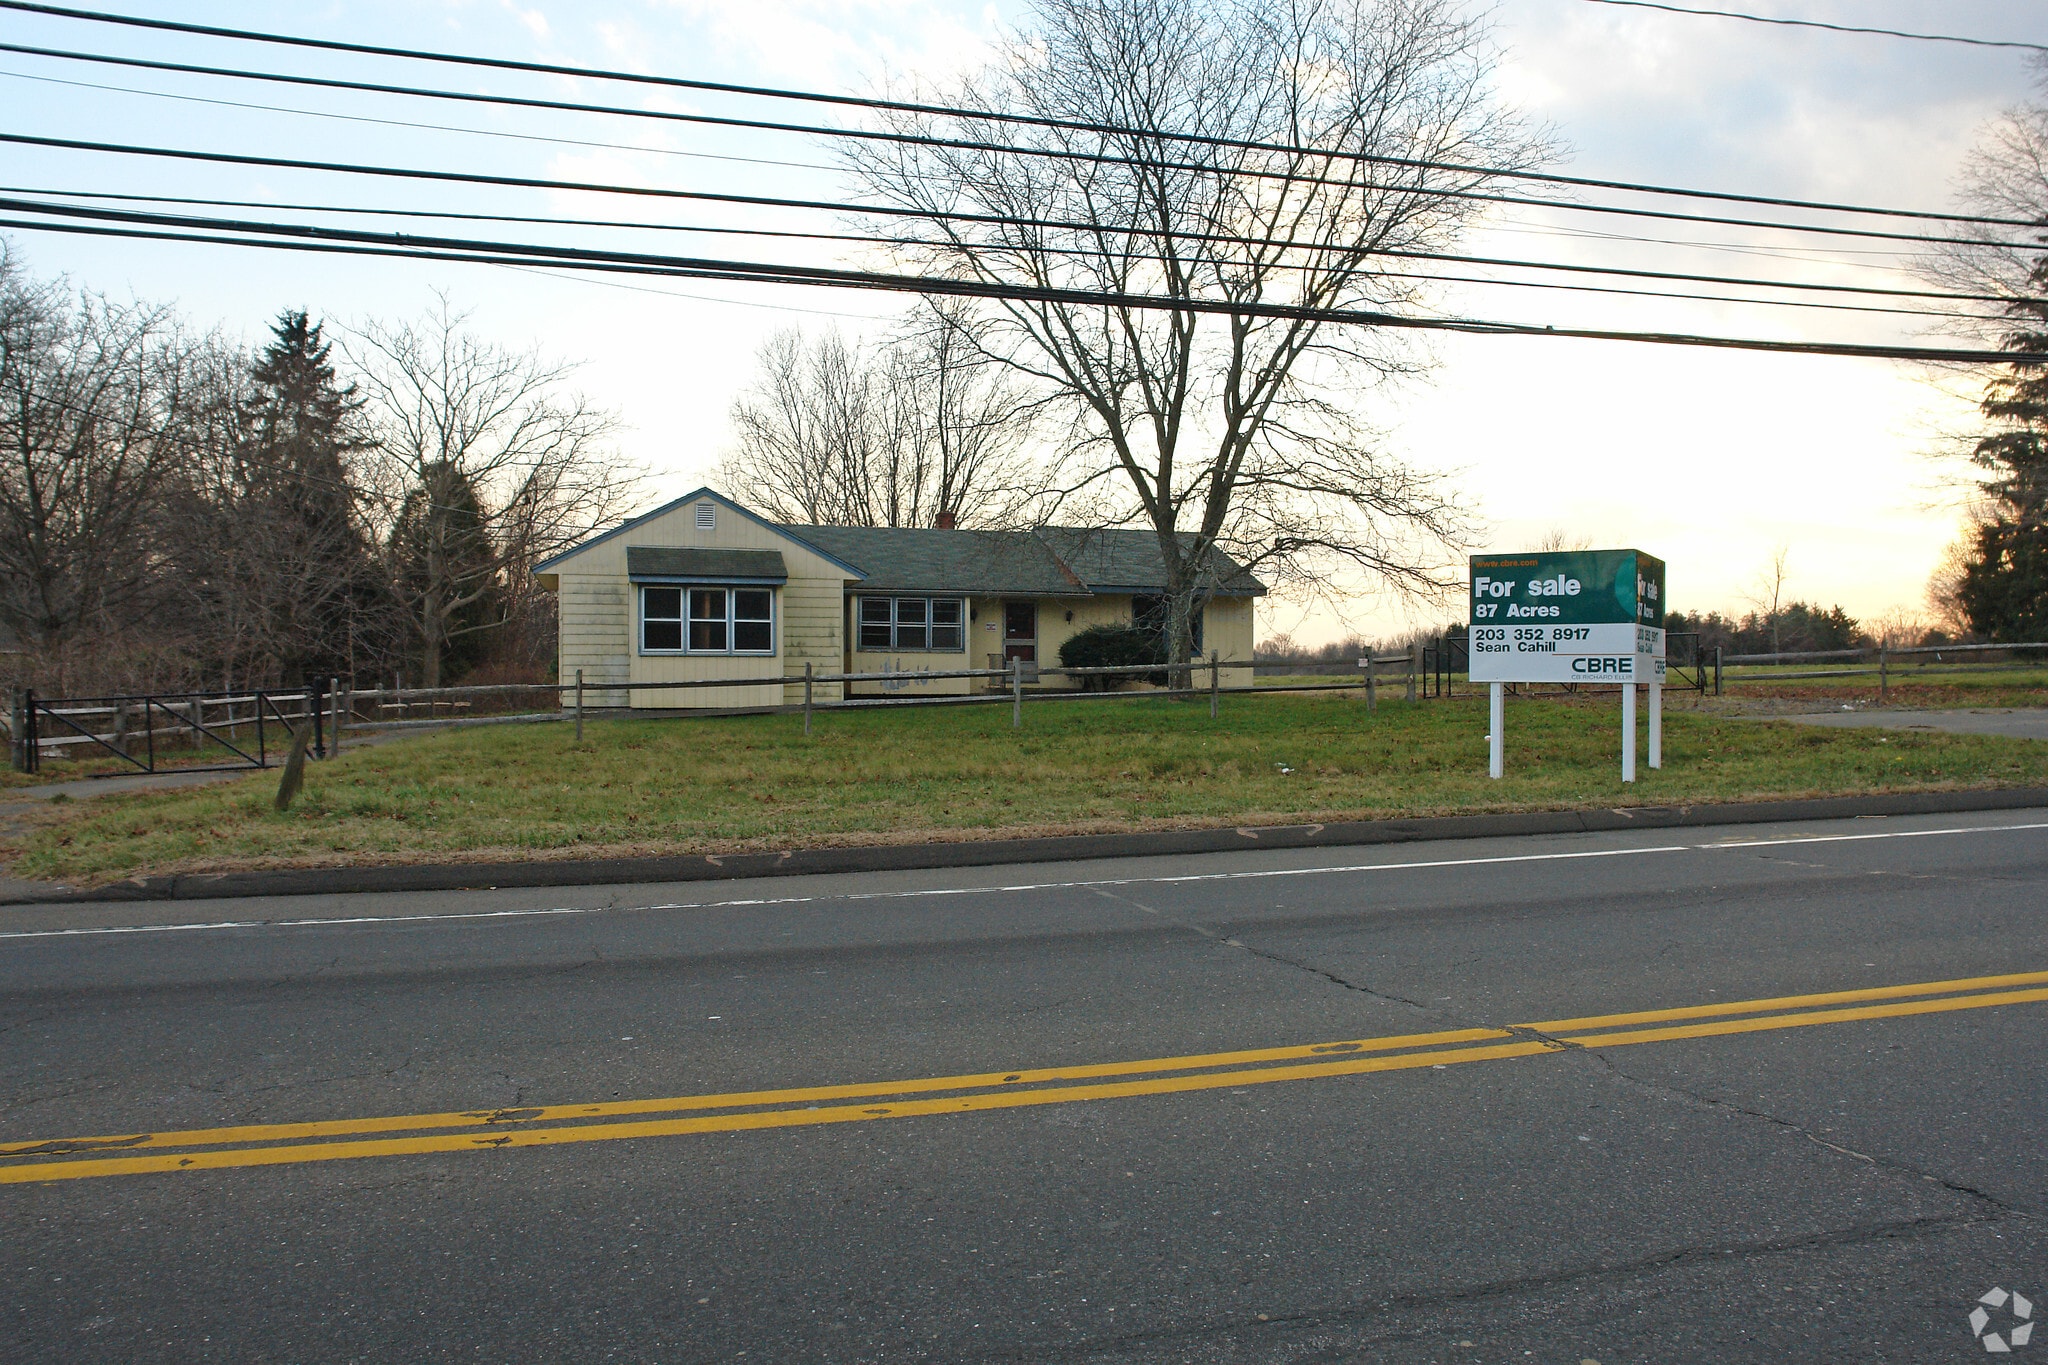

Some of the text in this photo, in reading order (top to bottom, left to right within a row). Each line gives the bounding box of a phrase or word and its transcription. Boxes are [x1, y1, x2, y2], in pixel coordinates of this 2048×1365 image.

[1475, 559, 1539, 568] www.cbre.com
[1475, 574, 1581, 598] For sale
[1475, 603, 1560, 618] 87 Acres
[1475, 628, 1590, 641] 203 352 8917
[1475, 641, 1556, 652] Sean Cahill
[1572, 658, 1632, 673] CBRE
